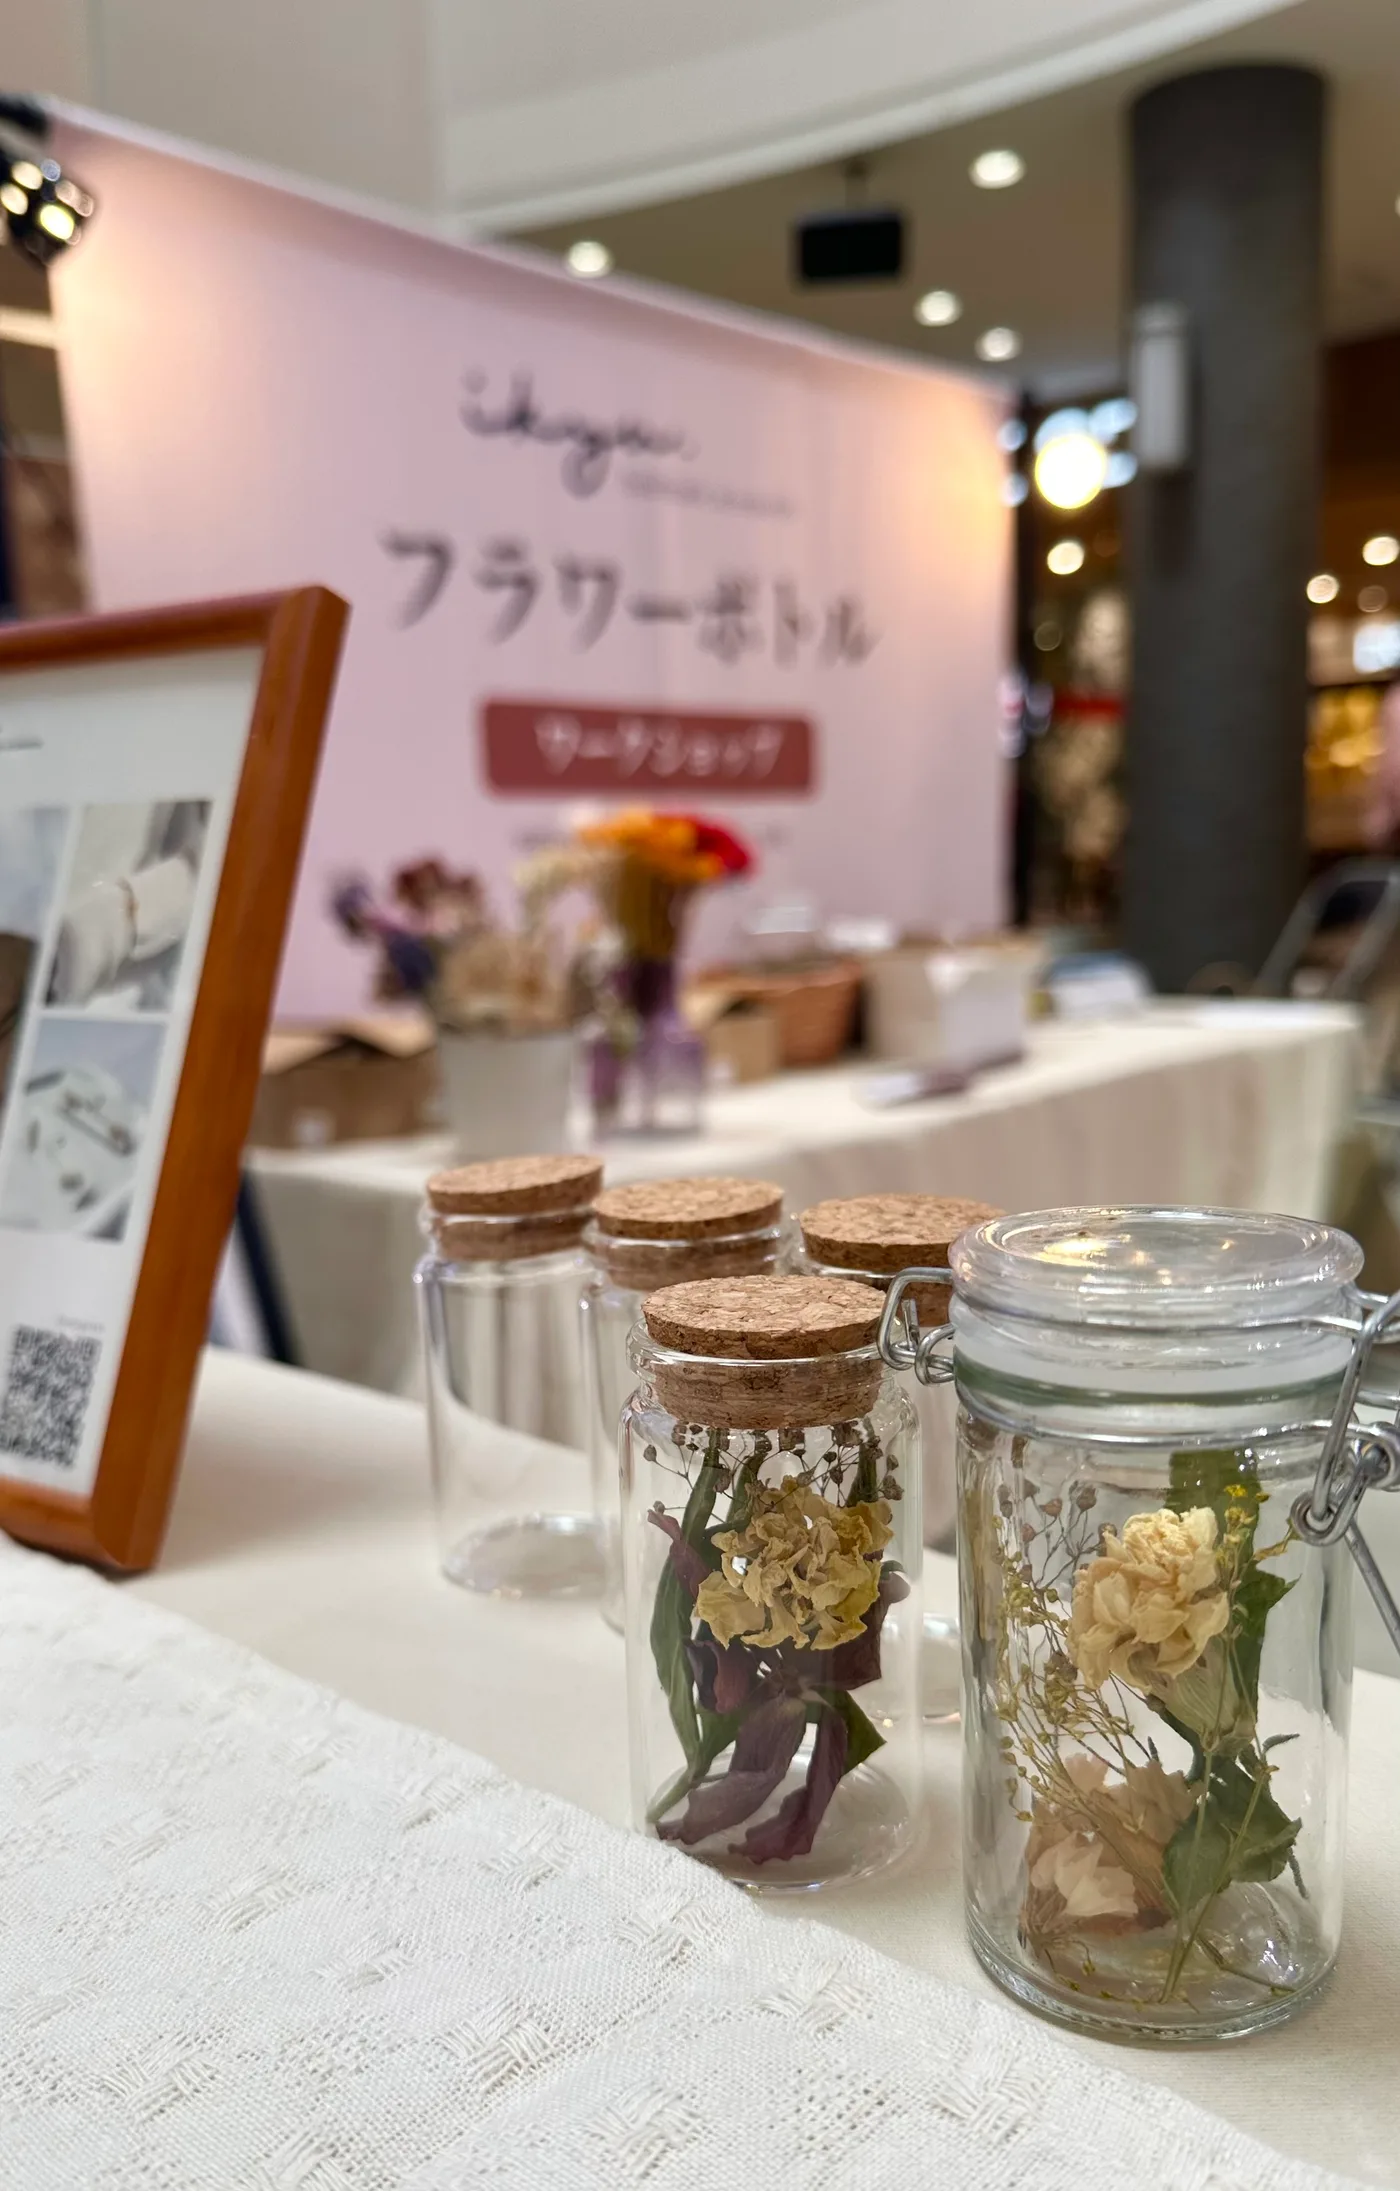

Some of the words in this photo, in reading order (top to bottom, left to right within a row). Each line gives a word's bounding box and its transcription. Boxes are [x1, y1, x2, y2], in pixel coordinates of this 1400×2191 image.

[382, 530, 878, 666] フラワーボトル
[535, 713, 783, 778] ワークショップ
